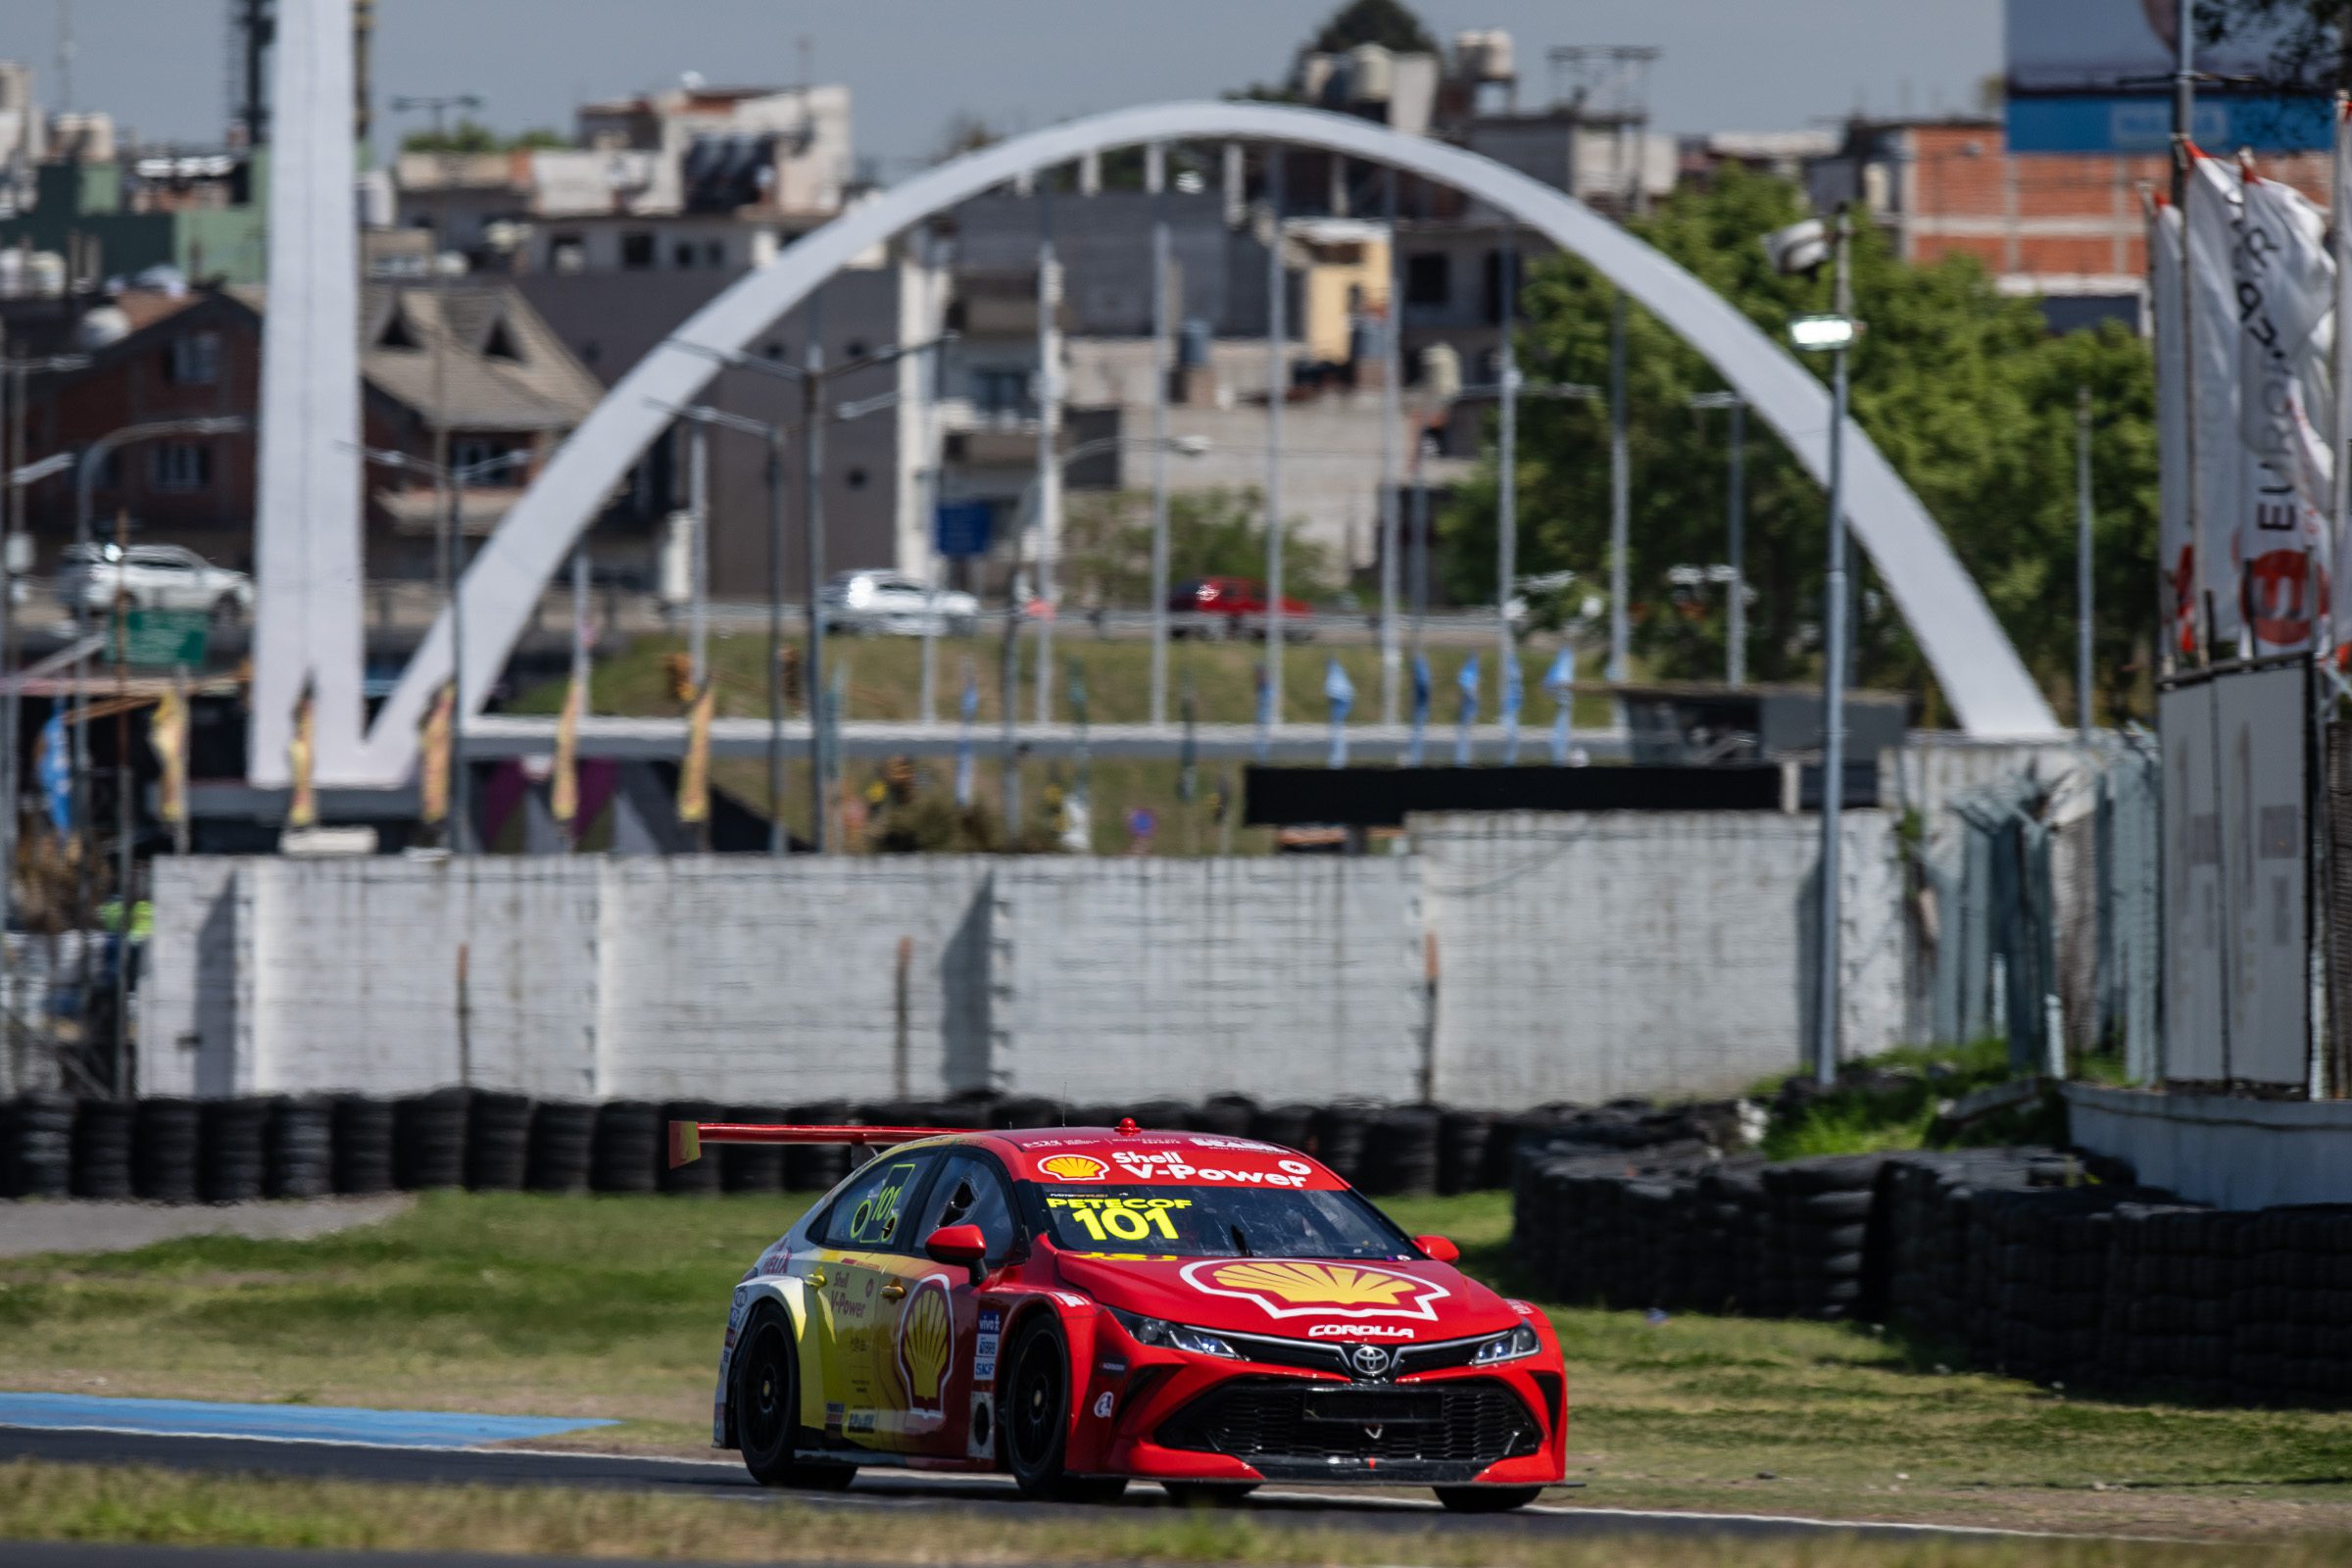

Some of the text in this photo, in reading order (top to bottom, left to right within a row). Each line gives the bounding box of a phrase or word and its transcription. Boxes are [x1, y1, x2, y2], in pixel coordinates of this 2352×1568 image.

[1111, 1152, 1184, 1164] Shell
[1120, 1163, 1306, 1188] V-Power
[871, 1186, 902, 1221] 101
[1046, 1198, 1193, 1209] PETECOF
[1072, 1207, 1179, 1241] 101
[834, 1271, 850, 1289] Shell
[830, 1290, 866, 1318] V-Power
[1307, 1324, 1415, 1339] COROLLA
